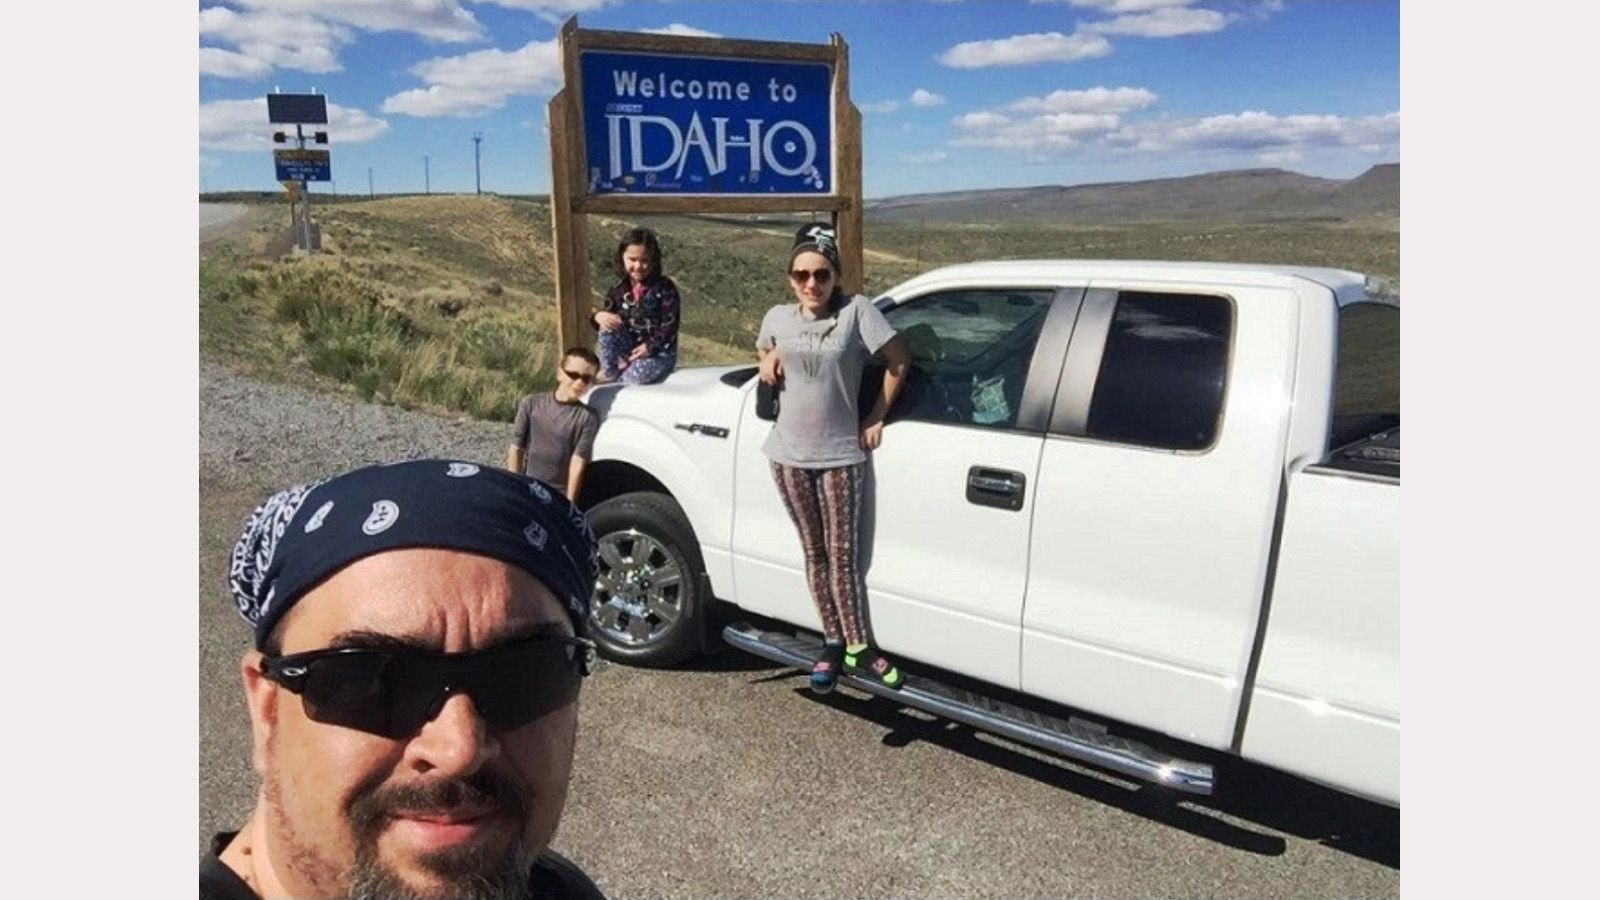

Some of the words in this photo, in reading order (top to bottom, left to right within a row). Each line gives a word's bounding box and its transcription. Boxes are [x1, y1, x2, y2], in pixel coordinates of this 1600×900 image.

[613, 70, 750, 100] Welcome
[768, 77, 797, 102] to
[604, 110, 817, 181] IDAHO
